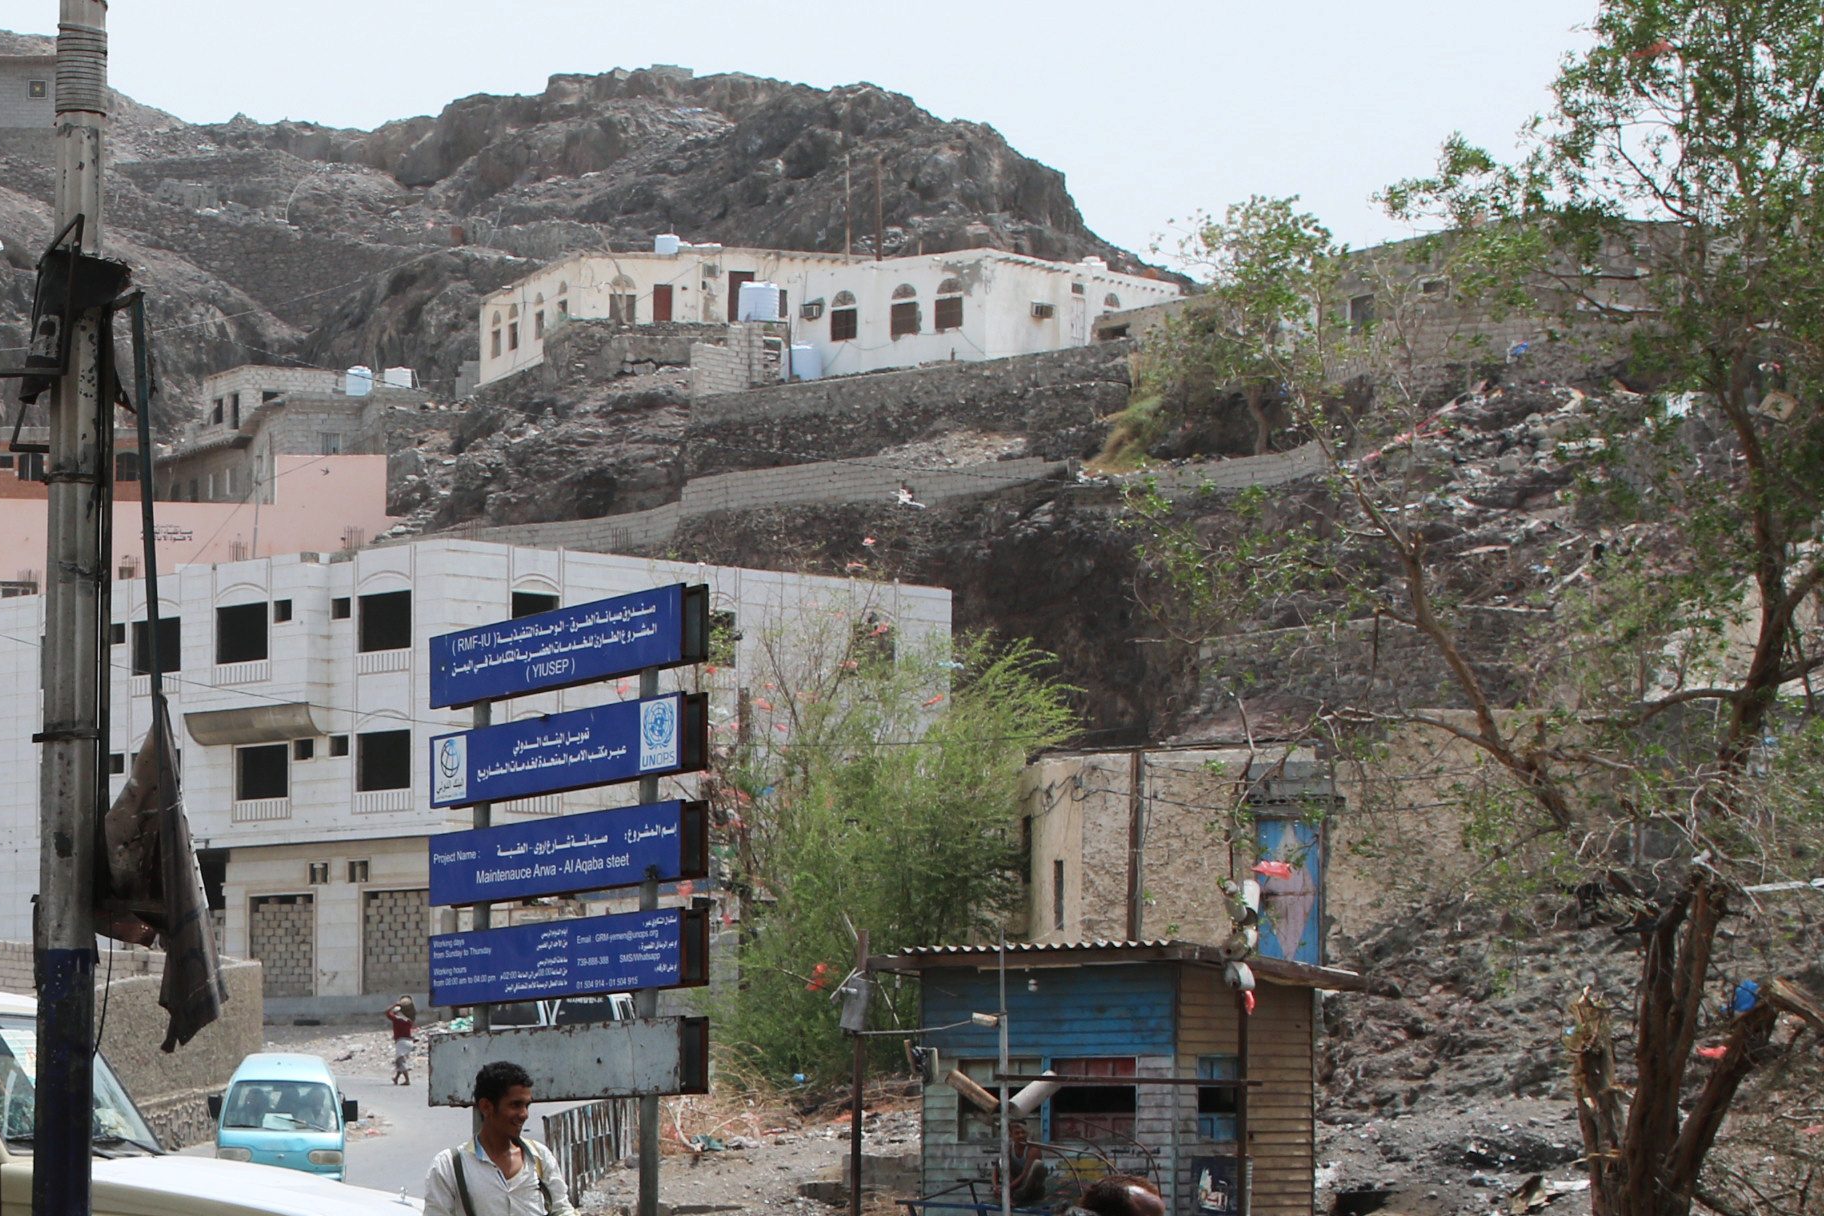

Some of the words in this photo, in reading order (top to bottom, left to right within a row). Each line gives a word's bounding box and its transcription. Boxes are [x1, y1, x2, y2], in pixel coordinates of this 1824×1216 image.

[596, 610, 623, 625] صيانة
[622, 603, 656, 622] صندوق
[535, 620, 565, 636] الوحدة
[570, 613, 596, 632] الطرق
[497, 625, 535, 646] التنفيذية
[622, 622, 657, 645] المشروع
[516, 643, 554, 663] الحضرية
[554, 635, 594, 654] للخدمات
[452, 660, 474, 677] اليمن
[474, 655, 489, 674] في
[532, 659, 569, 678] YIUSEP
[542, 731, 565, 748] البنك
[566, 727, 590, 746] تمويل
[513, 736, 542, 757] الدولي
[588, 745, 608, 763] مكتب
[607, 745, 627, 760] عبر
[510, 756, 539, 773] لخدمات
[538, 752, 568, 769] المتحدة
[641, 751, 675, 767] UNOPS
[477, 762, 511, 783] المشاريع
[571, 833, 608, 848] صيانة
[433, 851, 456, 866] Project
[456, 850, 477, 861] Name
[497, 842, 528, 859] العقبة
[476, 867, 532, 884] Maintenauce
[533, 863, 557, 878] Arwa
[564, 859, 573, 874] Al
[574, 857, 604, 874] Aqaba
[606, 852, 629, 869] steet
[433, 940, 453, 949] Working
[453, 939, 465, 947] days
[576, 935, 591, 944] Email
[433, 951, 445, 959] from
[445, 950, 463, 959] Sunday
[469, 947, 491, 956] Thursday
[433, 968, 453, 976] Working
[453, 966, 467, 974] hours
[433, 979, 445, 987] from
[488, 975, 496, 983] pm
